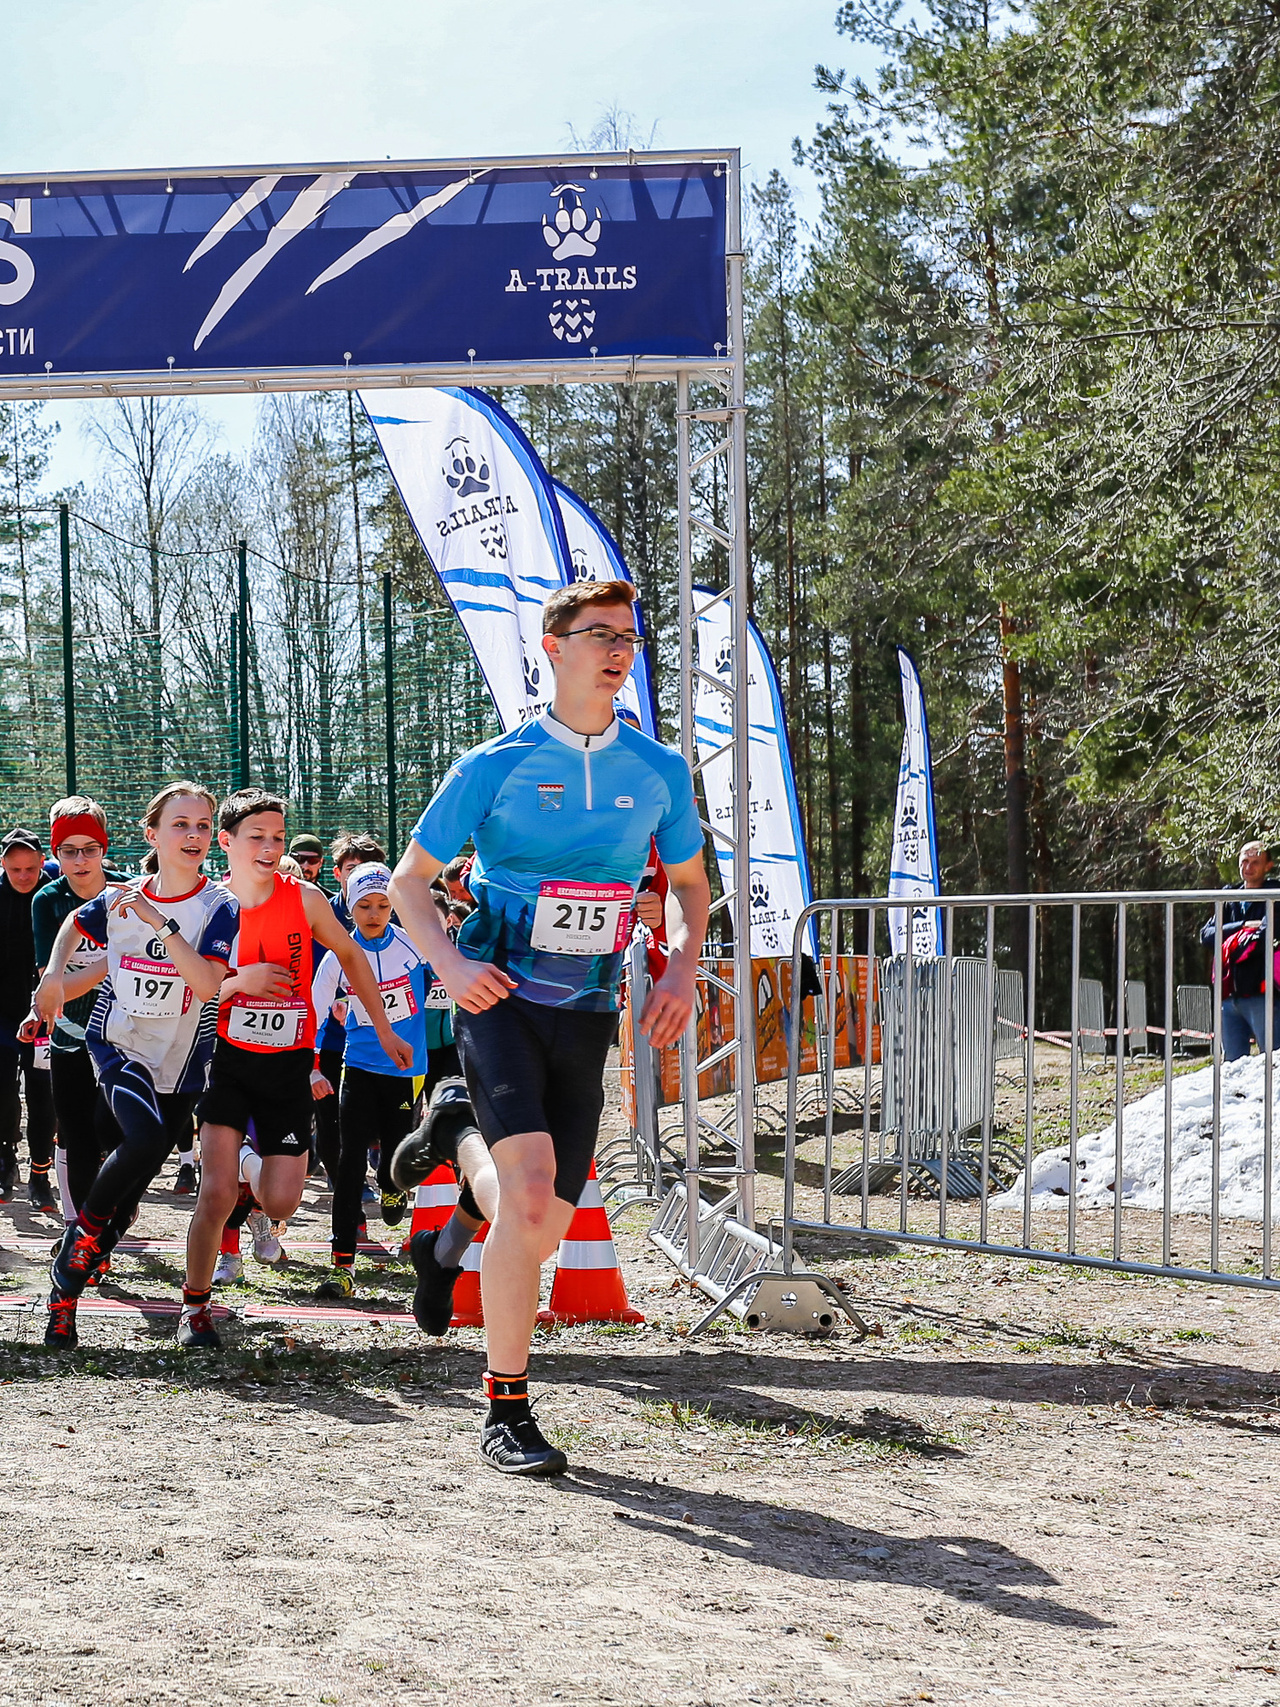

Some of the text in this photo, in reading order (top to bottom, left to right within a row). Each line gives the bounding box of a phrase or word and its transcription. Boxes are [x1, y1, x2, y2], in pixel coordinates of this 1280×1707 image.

[504, 265, 637, 292] A-TRAILS
[552, 904, 607, 932] 215
[133, 977, 174, 1000] 197
[242, 1011, 285, 1031] 210
